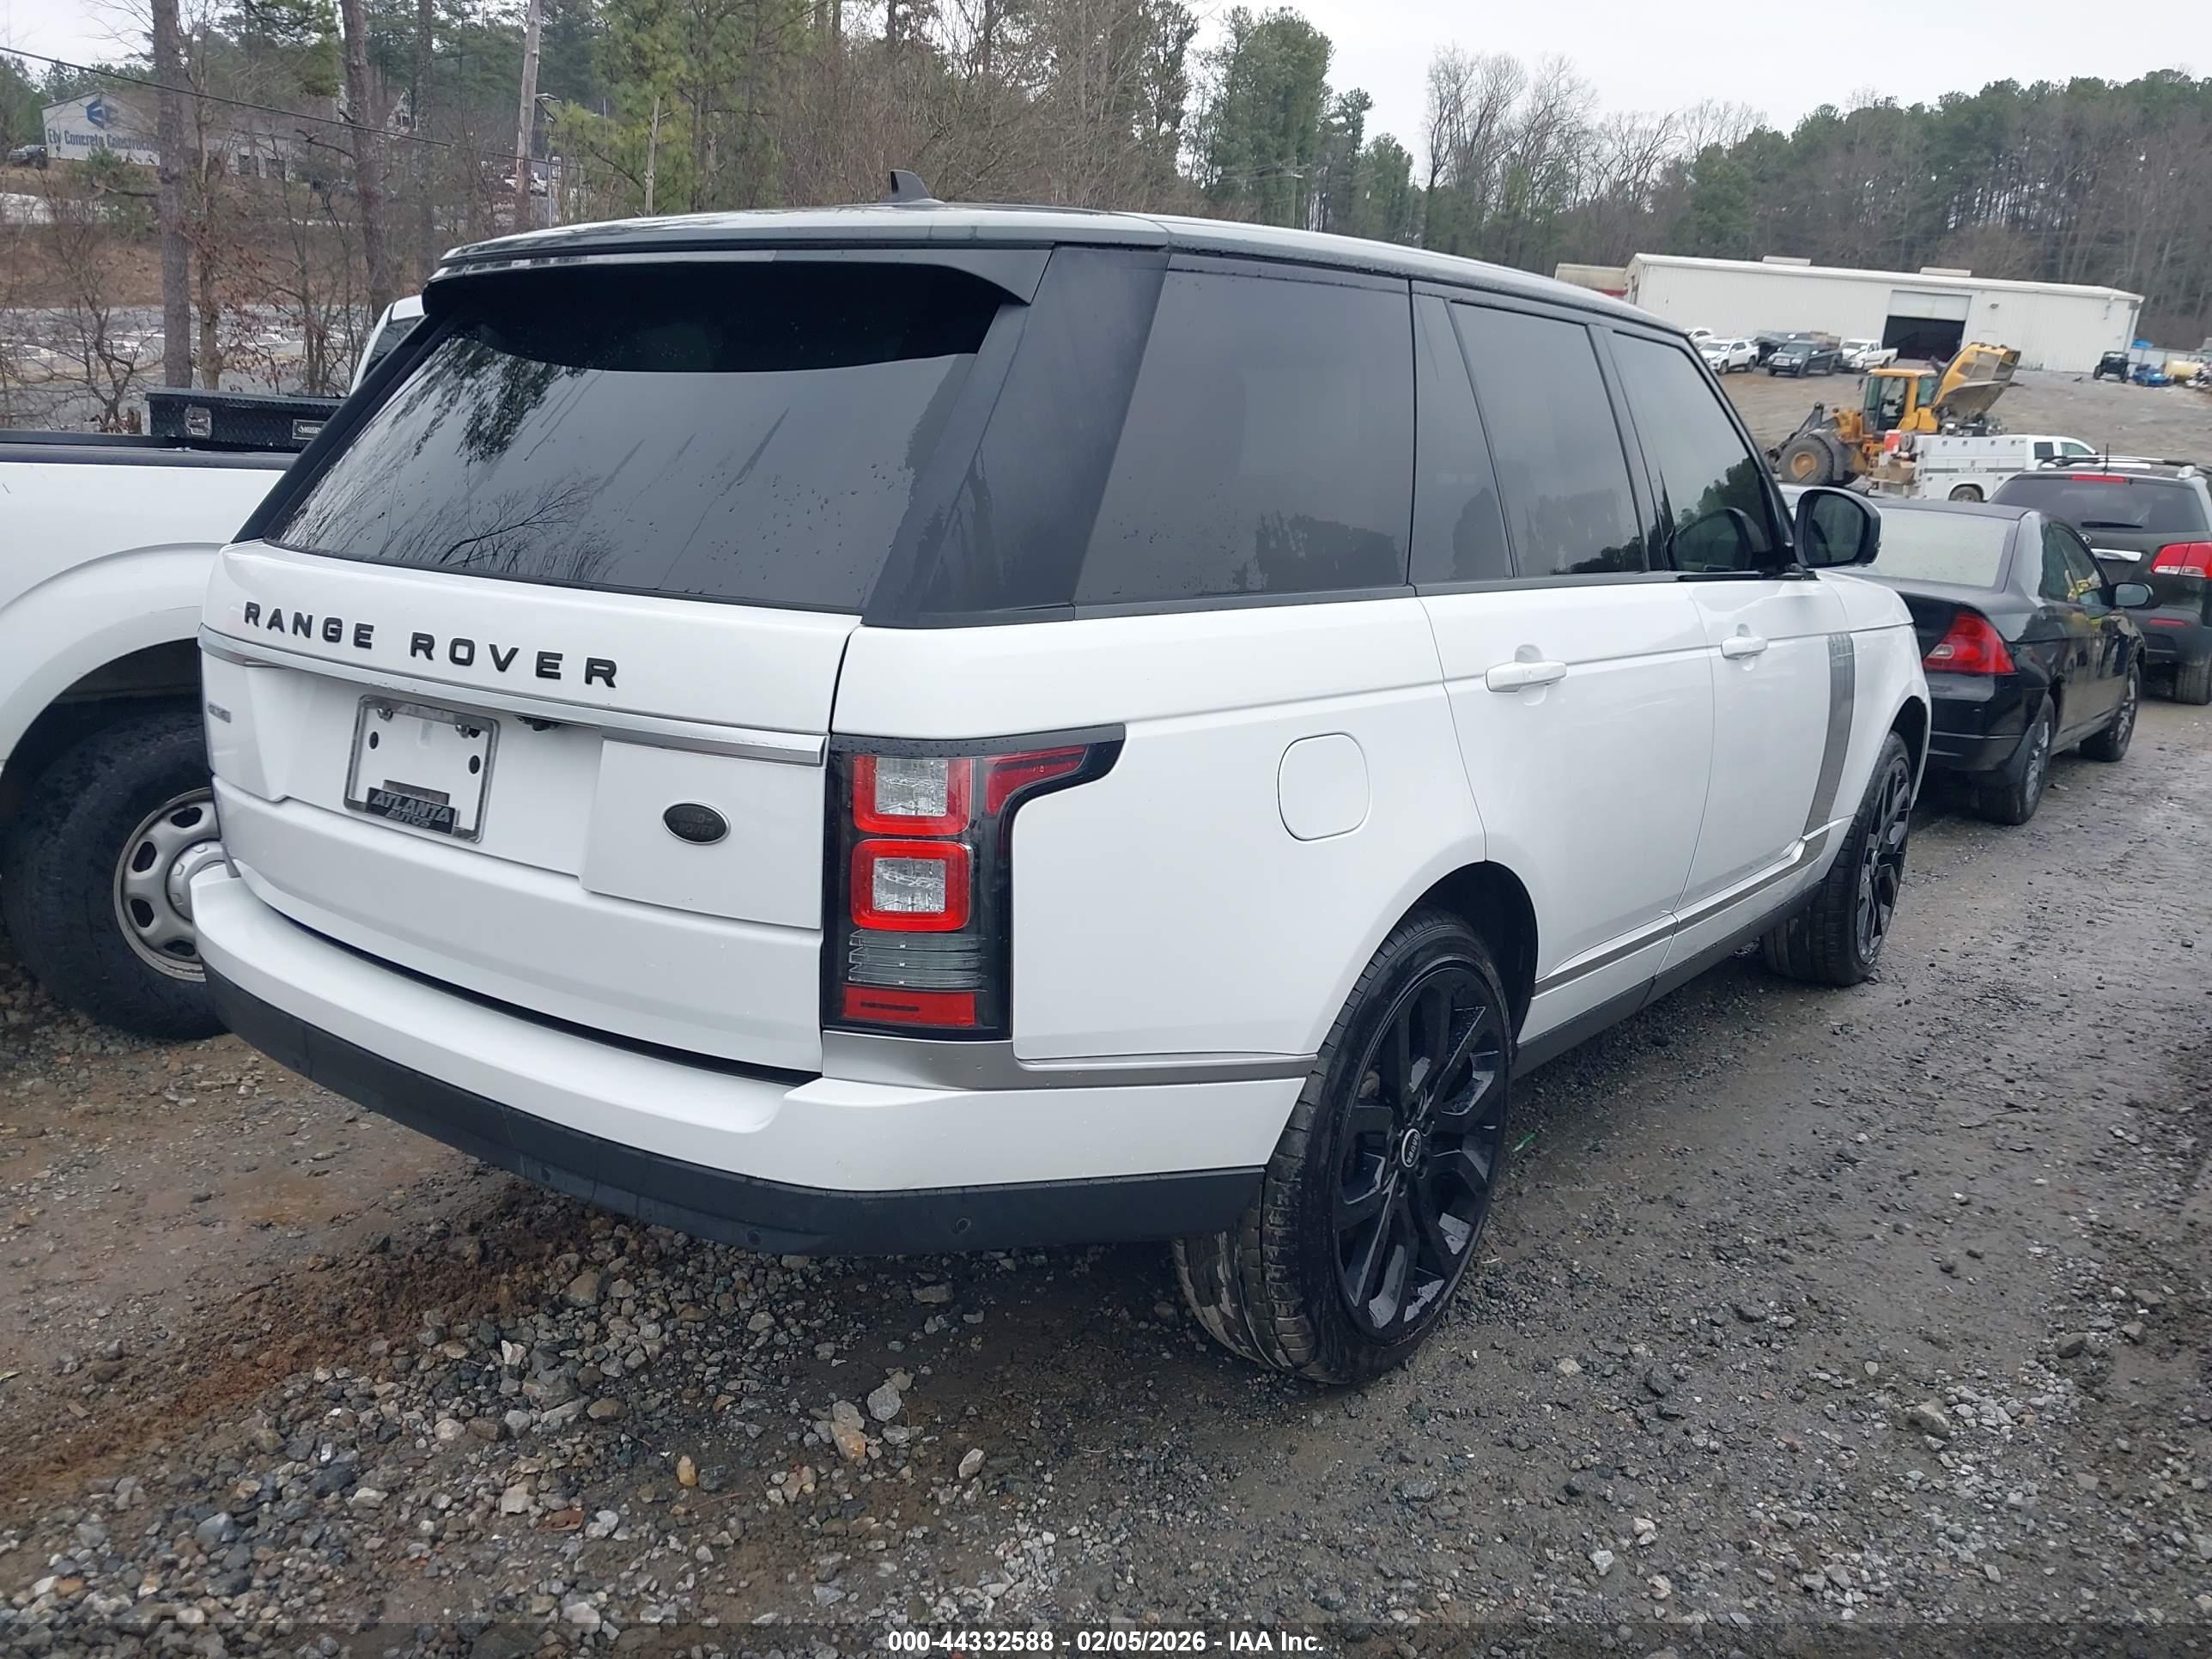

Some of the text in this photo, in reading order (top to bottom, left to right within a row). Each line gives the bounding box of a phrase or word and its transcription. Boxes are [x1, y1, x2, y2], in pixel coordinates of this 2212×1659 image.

[244, 601, 617, 689] RANGE ROVER
[371, 790, 451, 823] ATLANTA
